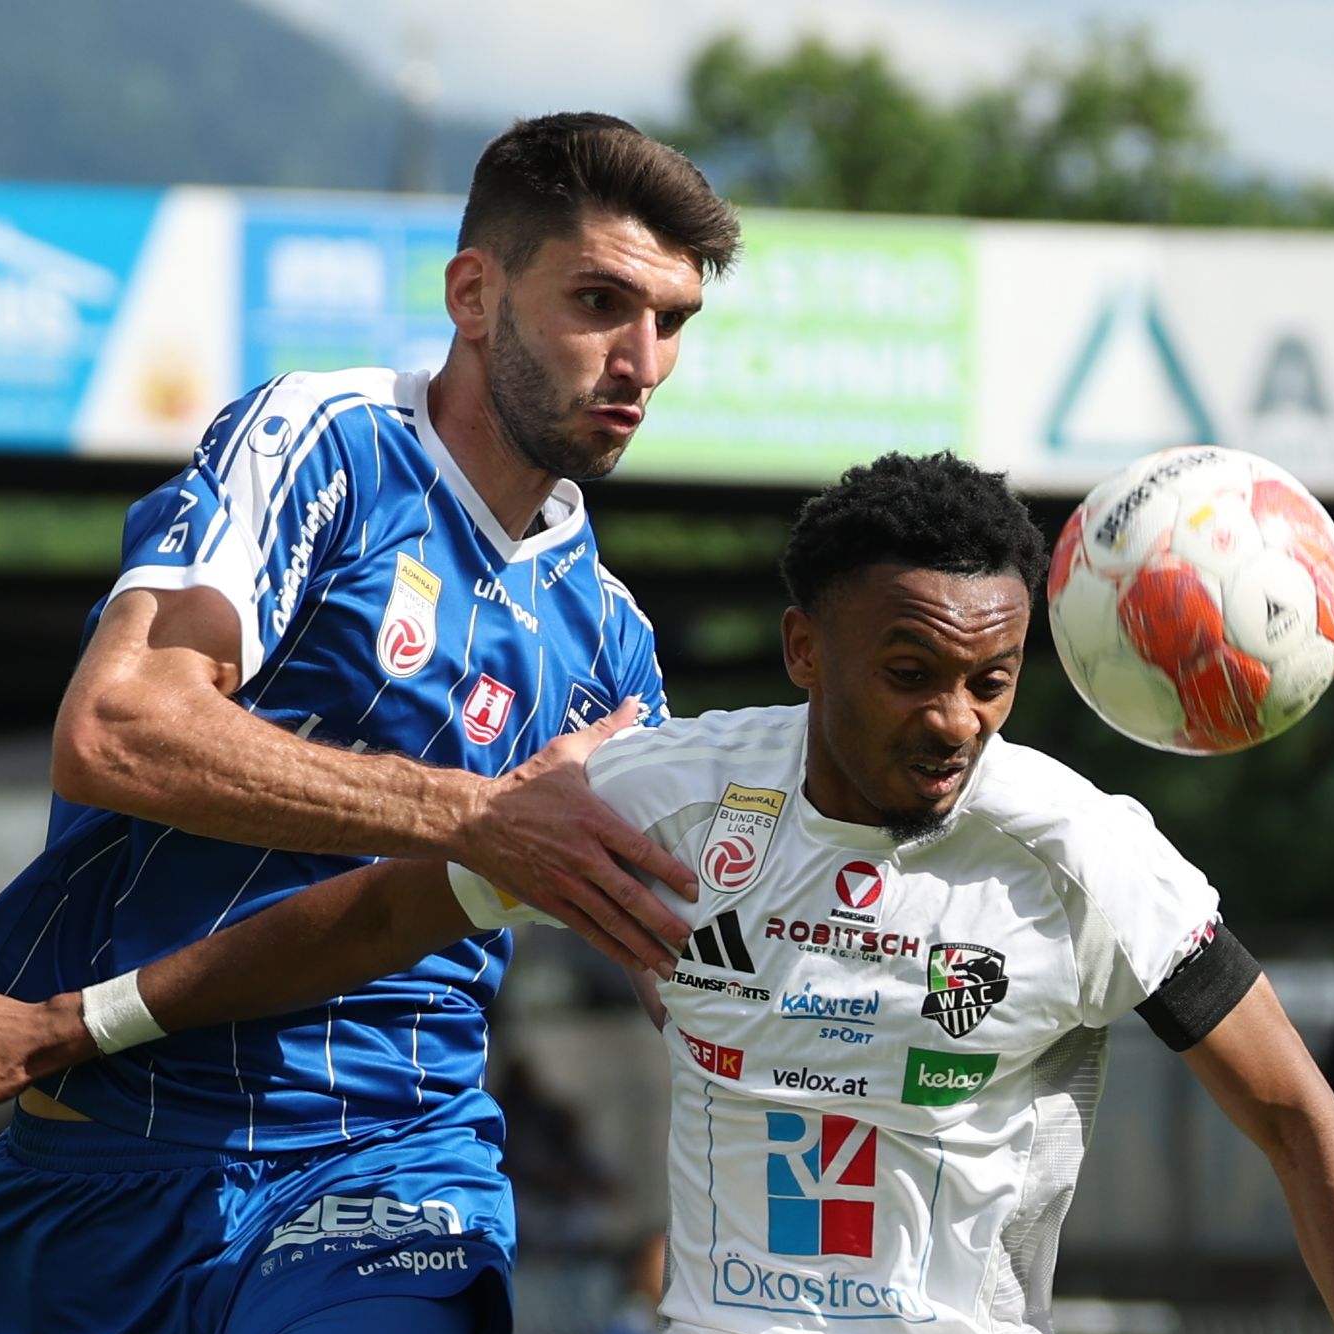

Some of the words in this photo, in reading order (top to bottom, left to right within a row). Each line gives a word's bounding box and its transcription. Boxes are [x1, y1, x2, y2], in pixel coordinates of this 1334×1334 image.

[727, 792, 779, 809] ADMIRAL
[719, 809, 773, 829] BUNDES
[727, 823, 755, 836] LIGA
[765, 917, 920, 958] ROBITSCH
[937, 985, 994, 1010] WAC
[819, 1027, 875, 1045] SPORT
[722, 1053, 738, 1074] K
[773, 1067, 869, 1097] velox.at
[918, 1063, 984, 1091] kelag
[723, 1250, 919, 1314] Ökostrom
